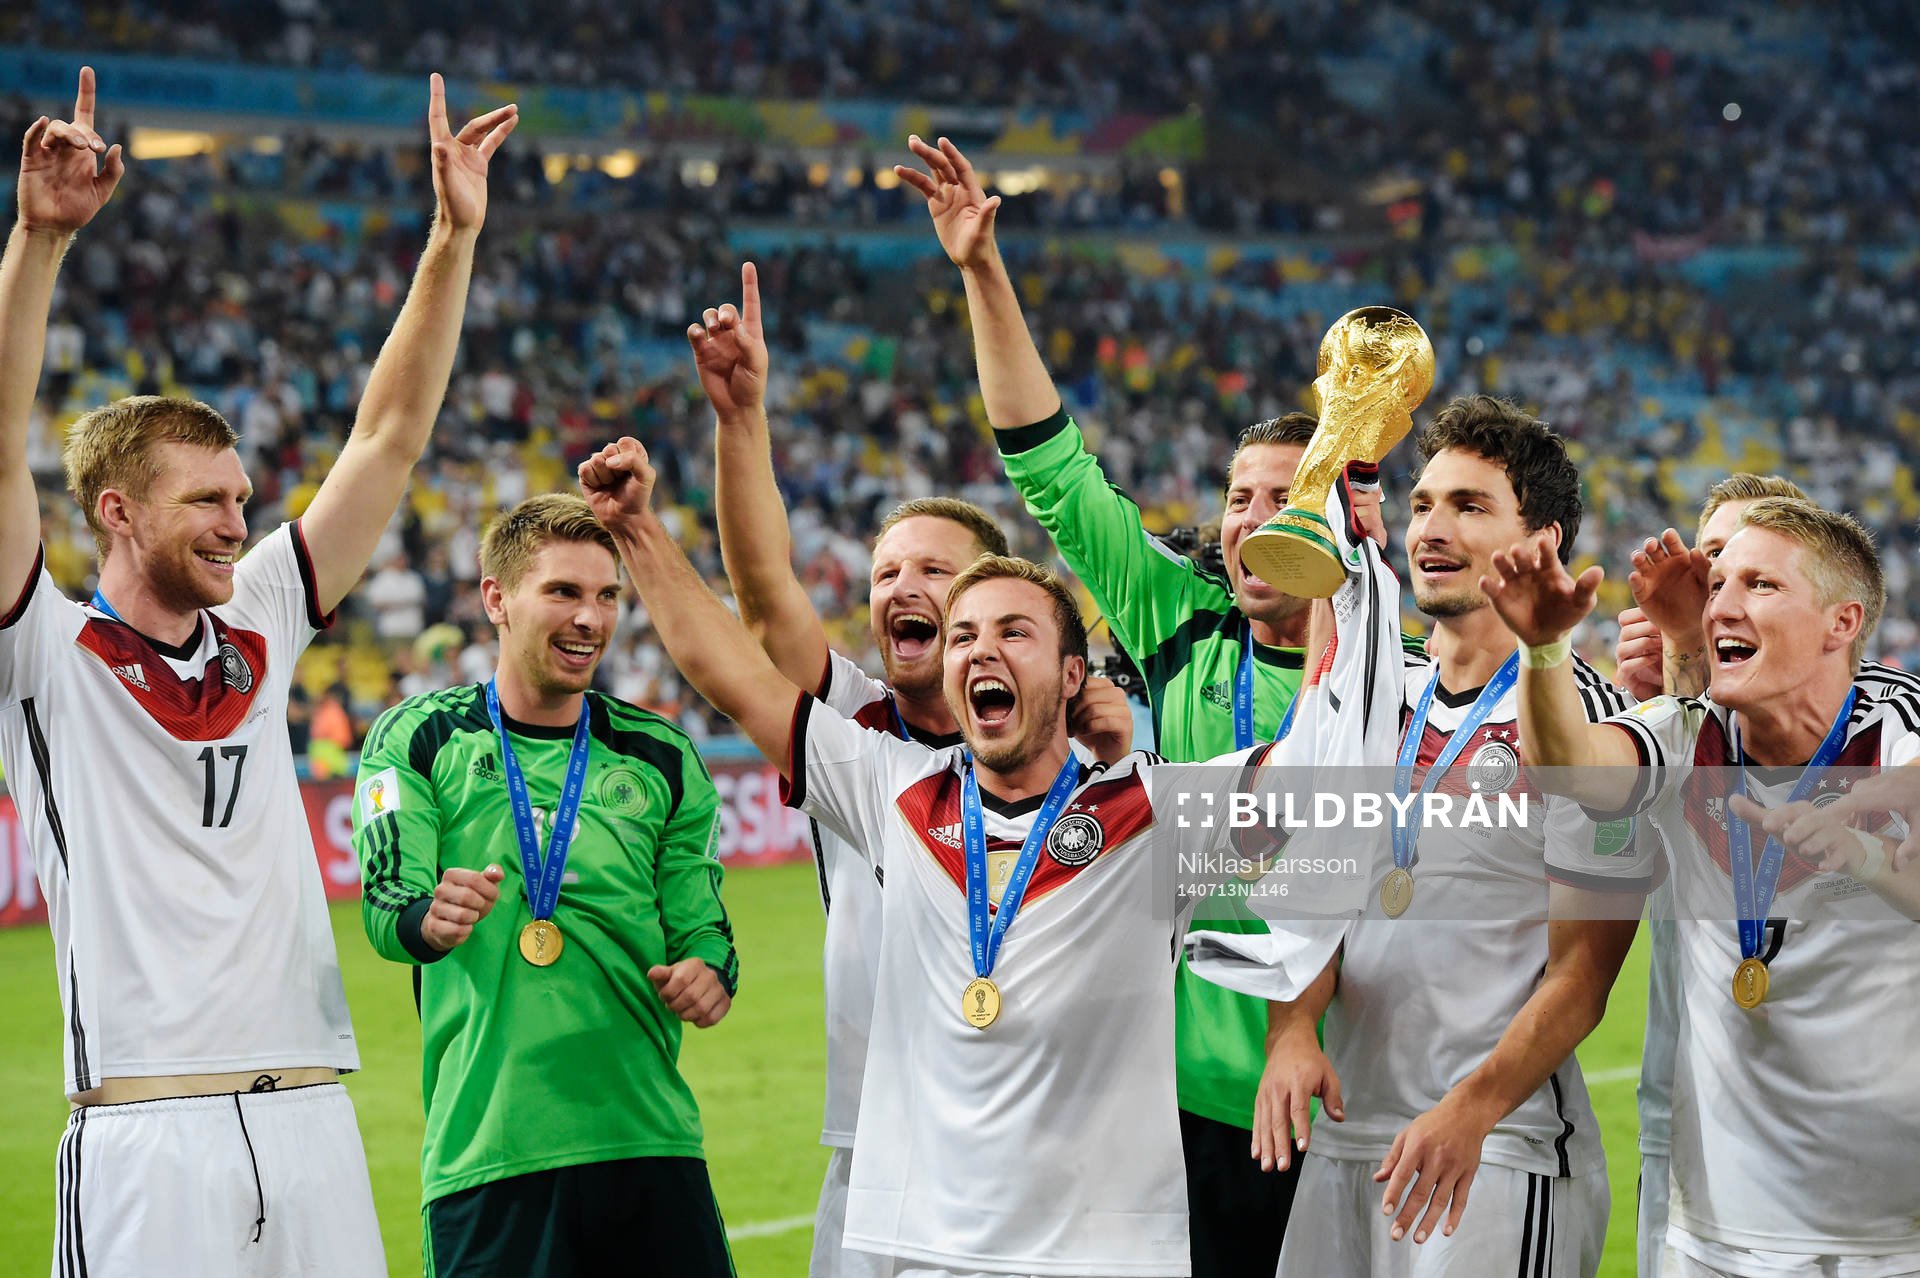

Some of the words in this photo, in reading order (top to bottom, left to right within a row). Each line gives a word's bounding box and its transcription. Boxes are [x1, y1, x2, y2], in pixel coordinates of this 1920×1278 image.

[112, 666, 151, 692] adidas
[1489, 680, 1504, 698] FIFA
[1473, 704, 1487, 720] FIFA
[1456, 727, 1469, 744] FIFA
[197, 745, 248, 827] 17
[1061, 774, 1072, 790] FIFA
[1049, 795, 1060, 812] FIFA
[1037, 817, 1048, 834] FIFA
[927, 828, 963, 850] adidas
[1026, 840, 1037, 858] FIFA
[1016, 866, 1027, 884] FIFA
[1764, 857, 1775, 876] FIFA
[974, 887, 982, 904] FIFA
[1005, 890, 1016, 908] FIFA
[1758, 886, 1768, 904] FIFA
[999, 916, 1008, 934] FIFA
[1760, 917, 1788, 968] 7
